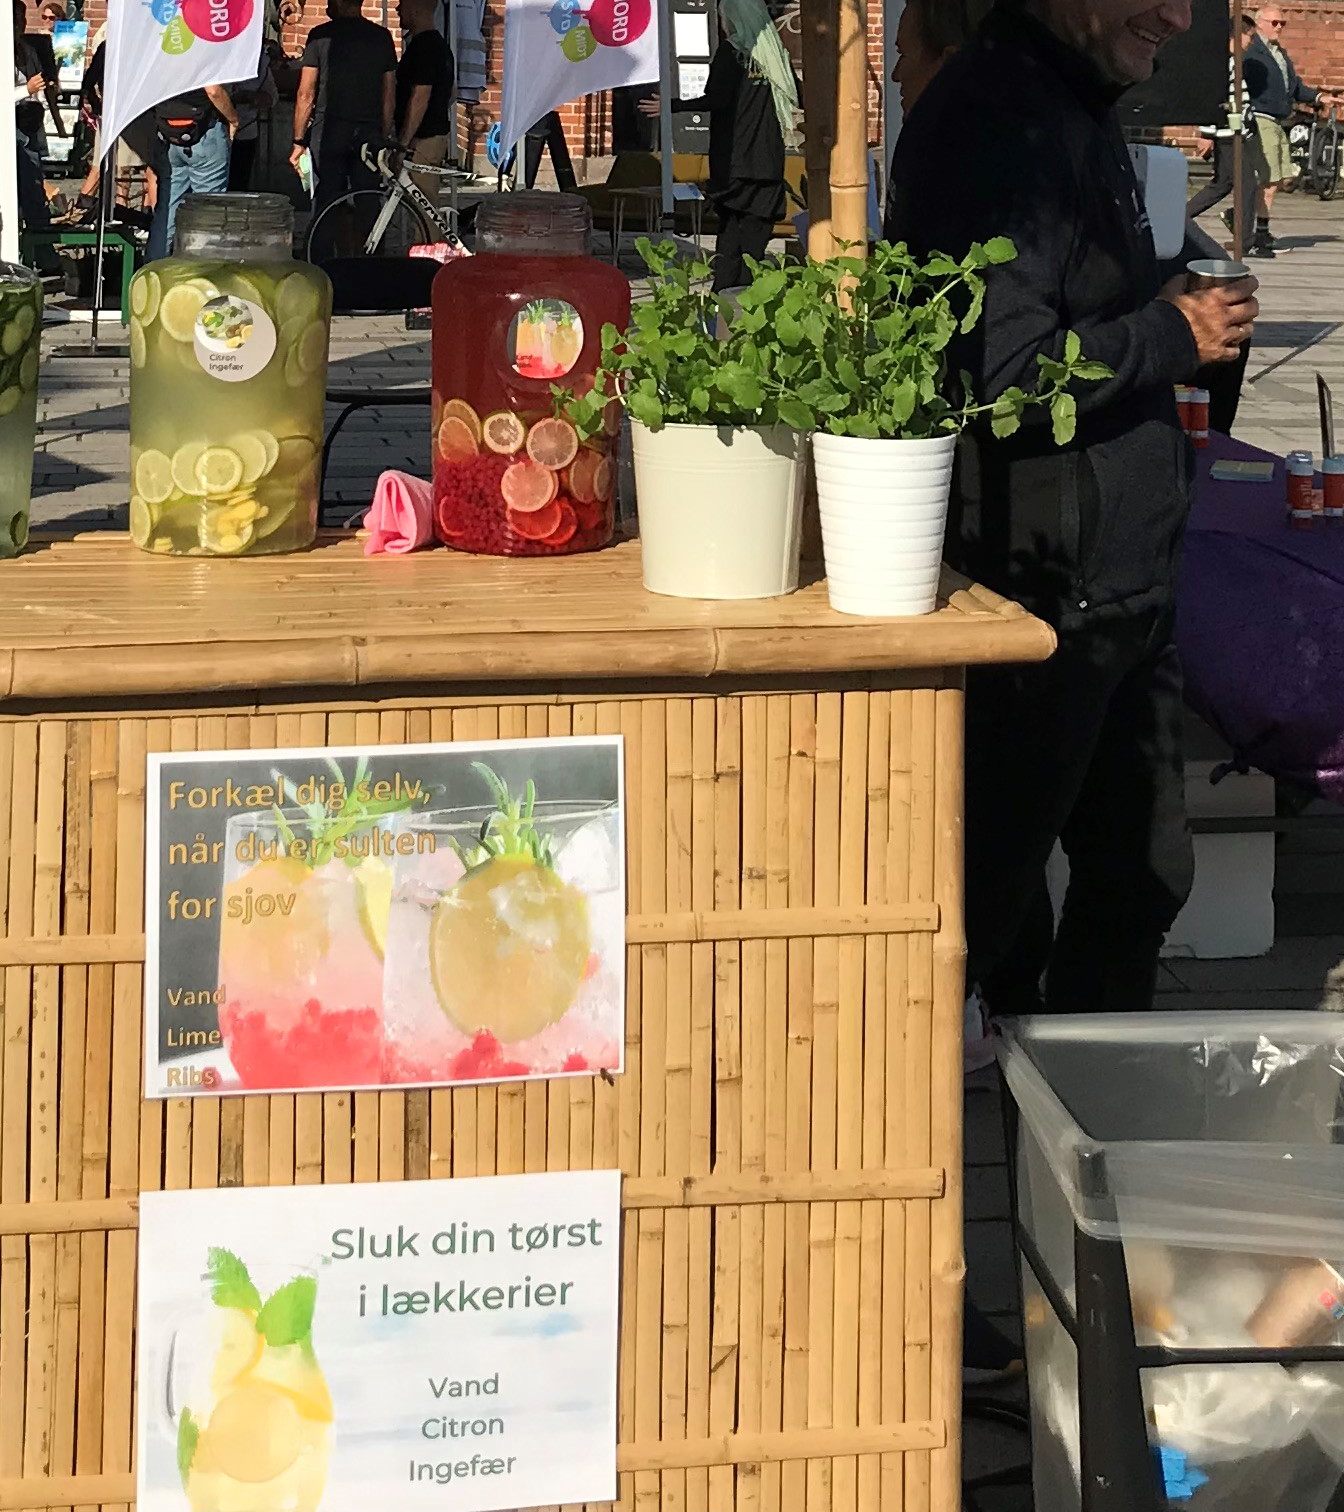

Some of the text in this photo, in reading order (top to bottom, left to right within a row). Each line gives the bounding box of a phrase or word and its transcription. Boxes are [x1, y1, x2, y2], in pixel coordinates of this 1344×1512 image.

[561, 0, 575, 31] SYD
[170, 19, 184, 50] MIDT
[576, 29, 587, 56] MIDT
[168, 772, 432, 810] Forkæl dig selv,
[168, 826, 437, 865] når du er sulten
[168, 887, 296, 924] for sjov
[166, 984, 226, 1007] Vand
[166, 1026, 222, 1048] Lime
[166, 1066, 216, 1088] Ribs
[331, 1216, 603, 1261] Sluk din tørst
[358, 1275, 574, 1316] i lækkerier
[428, 1372, 500, 1399] Vand
[421, 1413, 505, 1441] Citron
[409, 1453, 517, 1485] Ingefær
